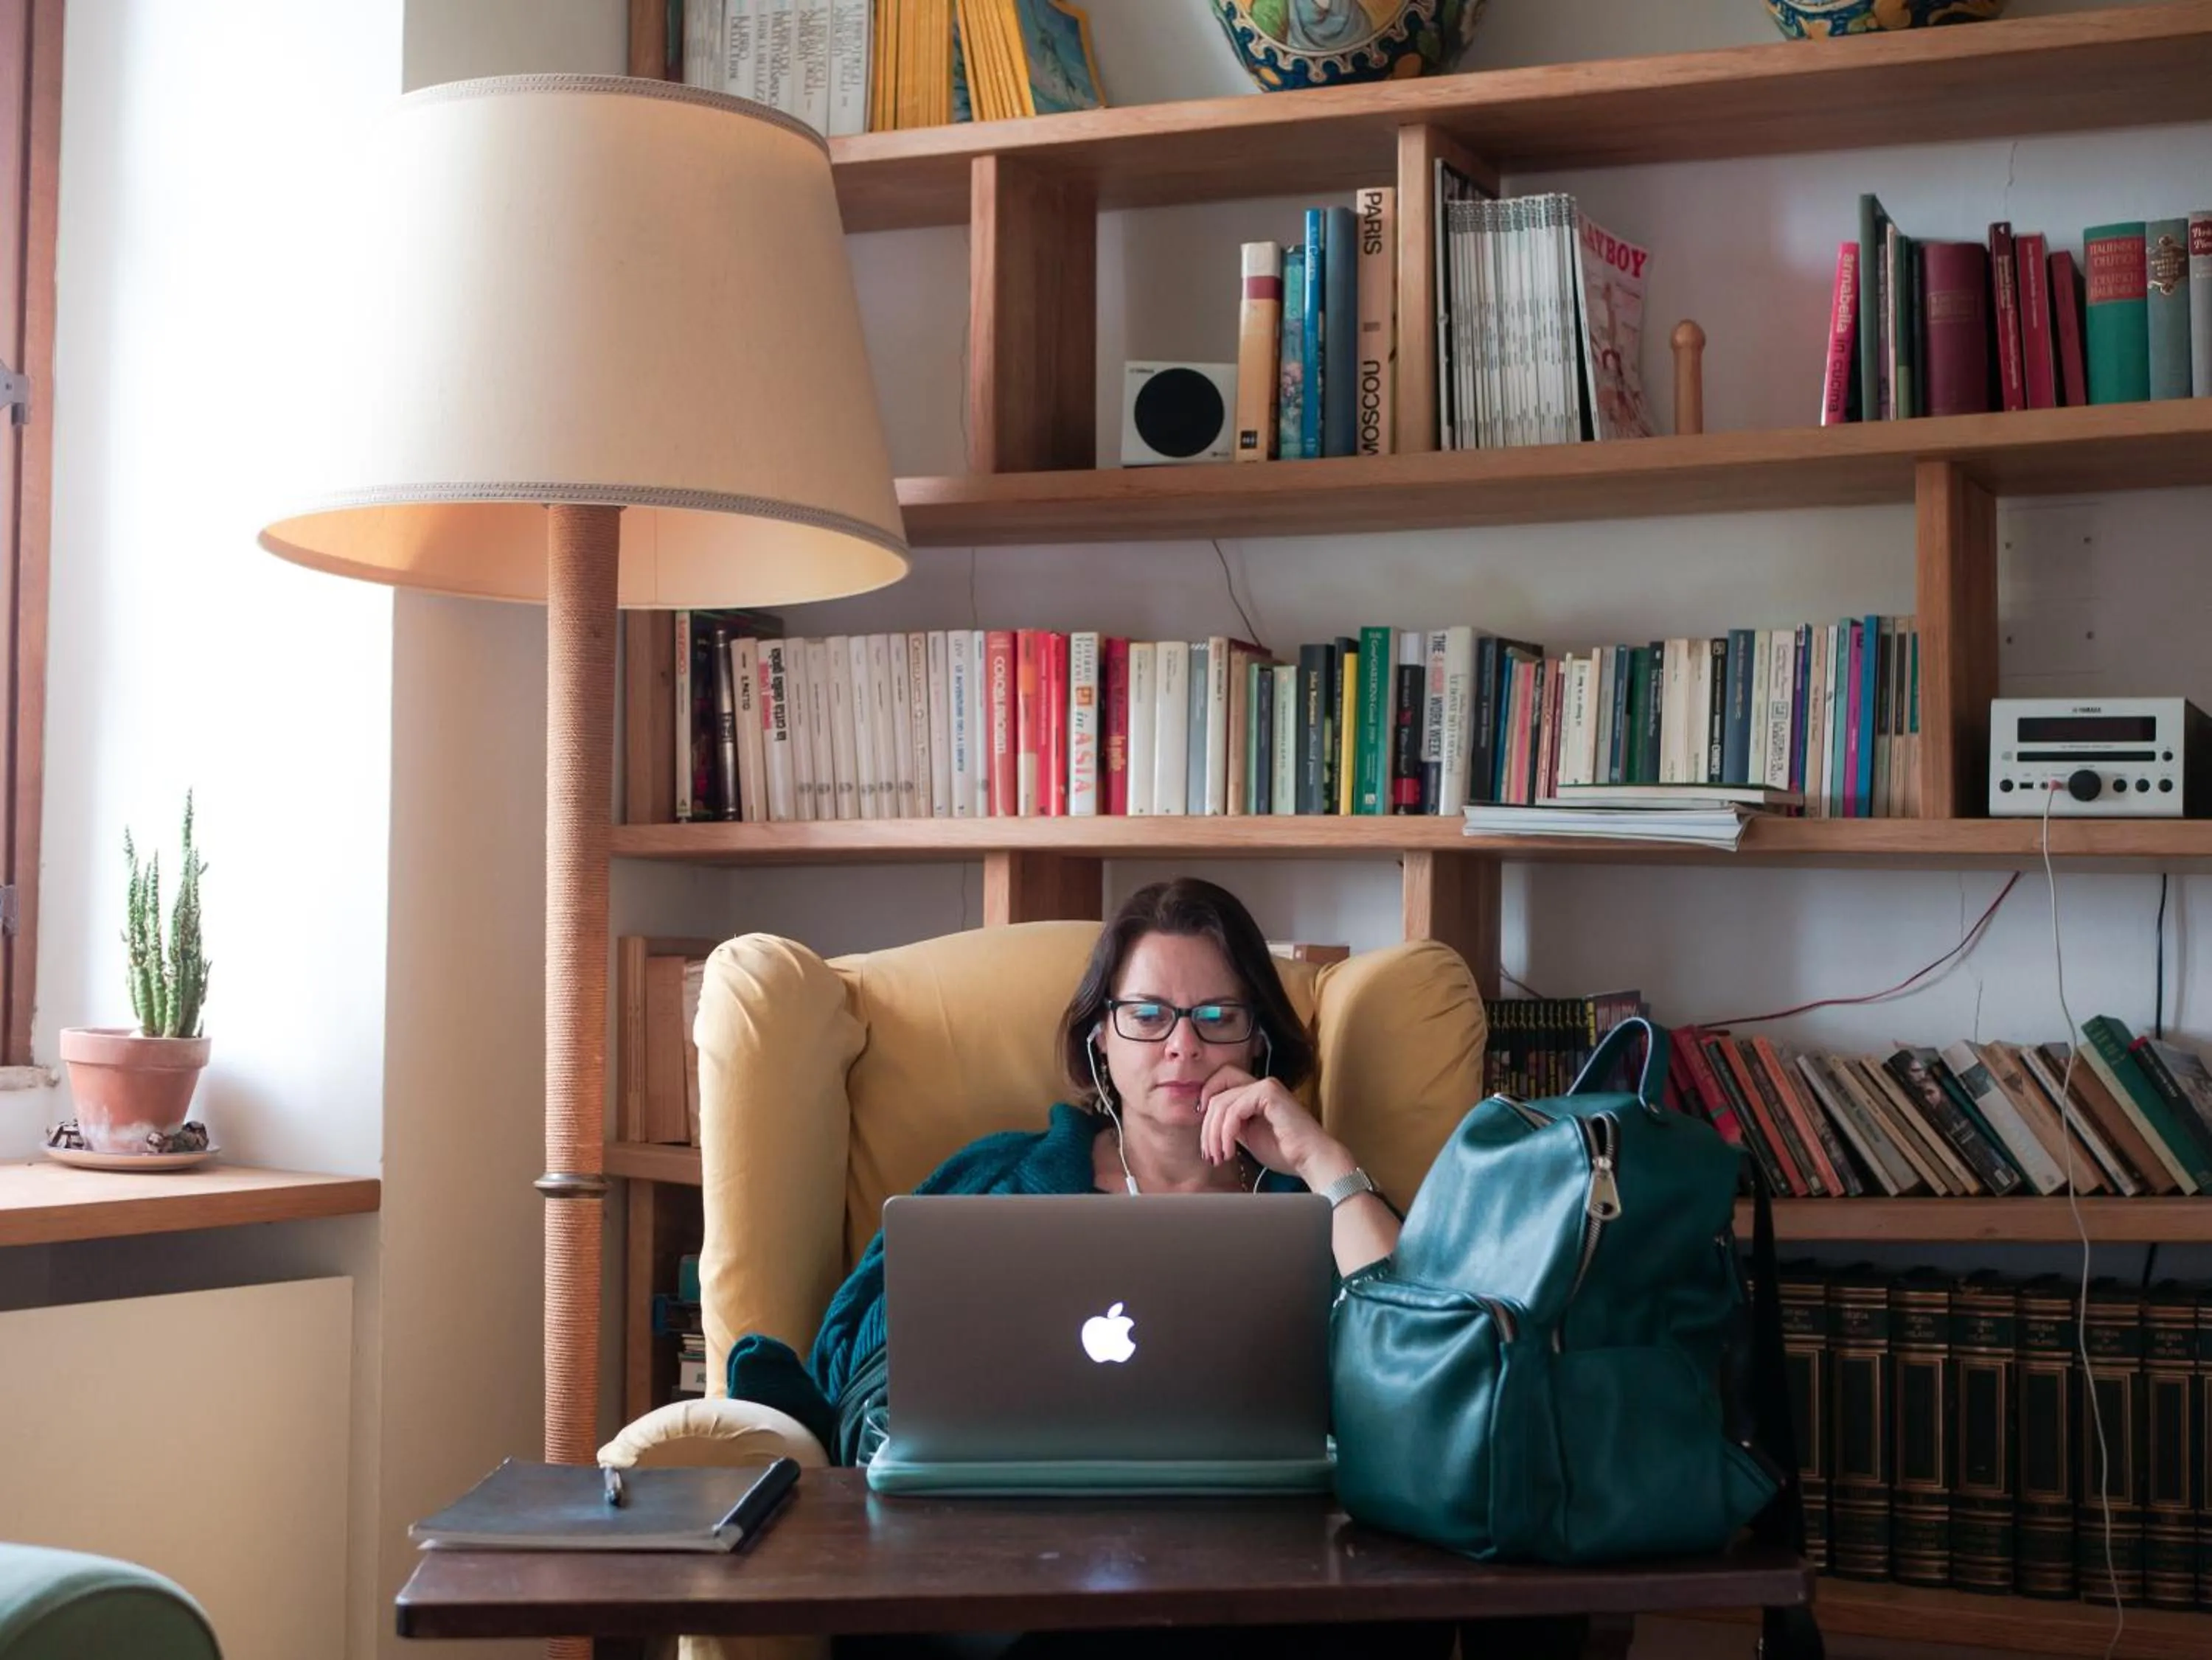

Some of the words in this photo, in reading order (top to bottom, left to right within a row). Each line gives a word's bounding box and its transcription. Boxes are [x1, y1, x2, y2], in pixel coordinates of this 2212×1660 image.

[1364, 192, 1382, 255] PARIS
[1835, 254, 1856, 334] annabella
[1834, 339, 1848, 353] in
[1362, 360, 1380, 456] MOSCOU
[1828, 359, 1846, 414] cucina
[1083, 637, 1093, 681] Tiziano
[1431, 633, 1447, 653] THE
[1075, 711, 1089, 728] in
[1429, 696, 1444, 727] WORK
[1075, 731, 1094, 795] ASIA
[1428, 728, 1444, 757] WEEK
